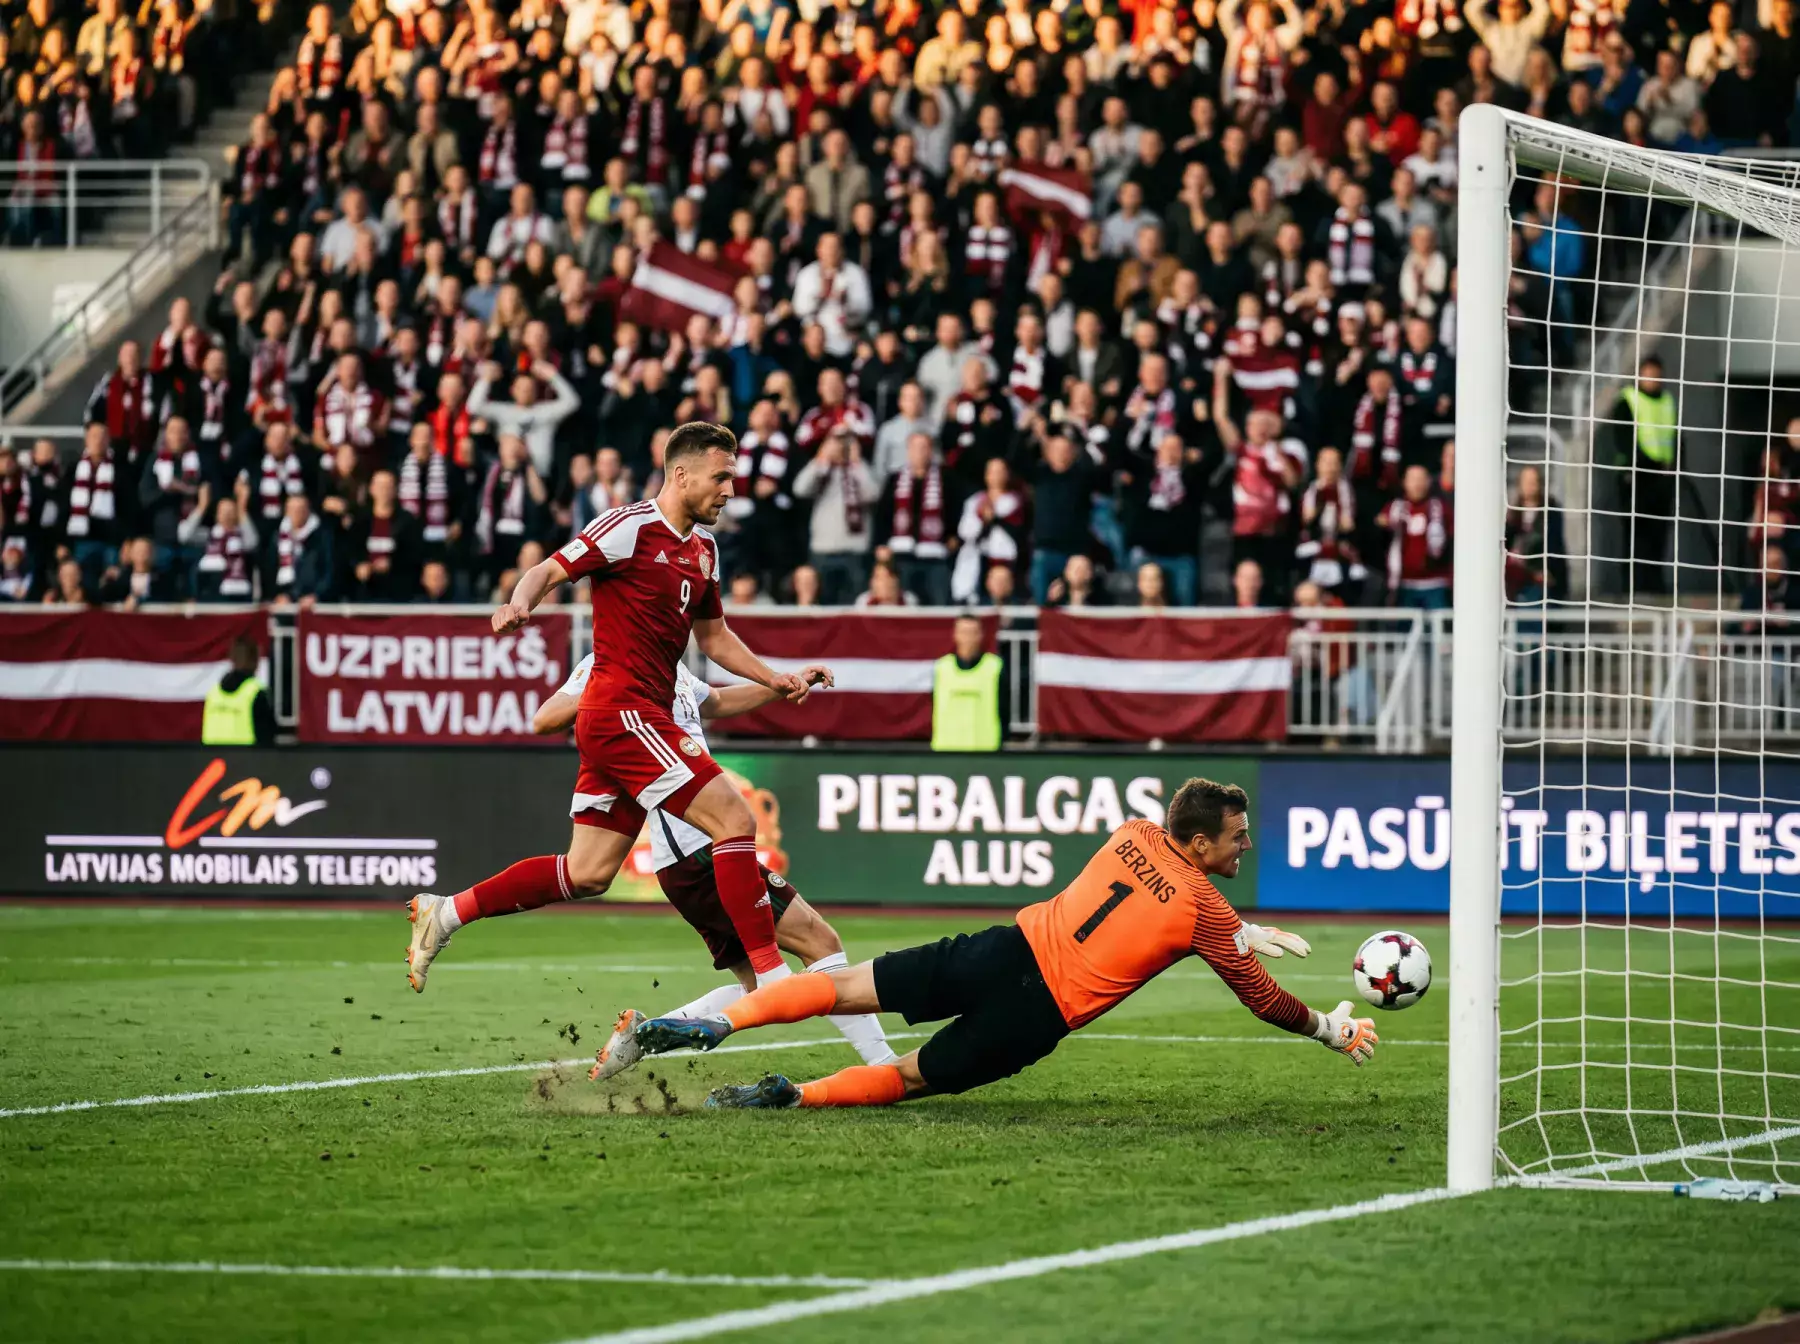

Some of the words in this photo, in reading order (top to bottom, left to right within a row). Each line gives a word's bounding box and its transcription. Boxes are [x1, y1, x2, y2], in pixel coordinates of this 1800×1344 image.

[679, 579, 691, 615] 9
[305, 625, 561, 686] UZPRIEKŠ,
[327, 687, 540, 735] LATVIJA!
[817, 774, 1166, 834] PIEBALGAS
[45, 853, 164, 884] LATVIJAS
[170, 854, 299, 886] MOBILAIS
[304, 855, 438, 887] TELEFONS
[923, 839, 1056, 888] ALUS
[1114, 839, 1177, 904] BERZINS
[1287, 795, 1549, 871] PASŪT
[1565, 809, 1800, 894] BIĻETES
[1073, 880, 1135, 944] 1
